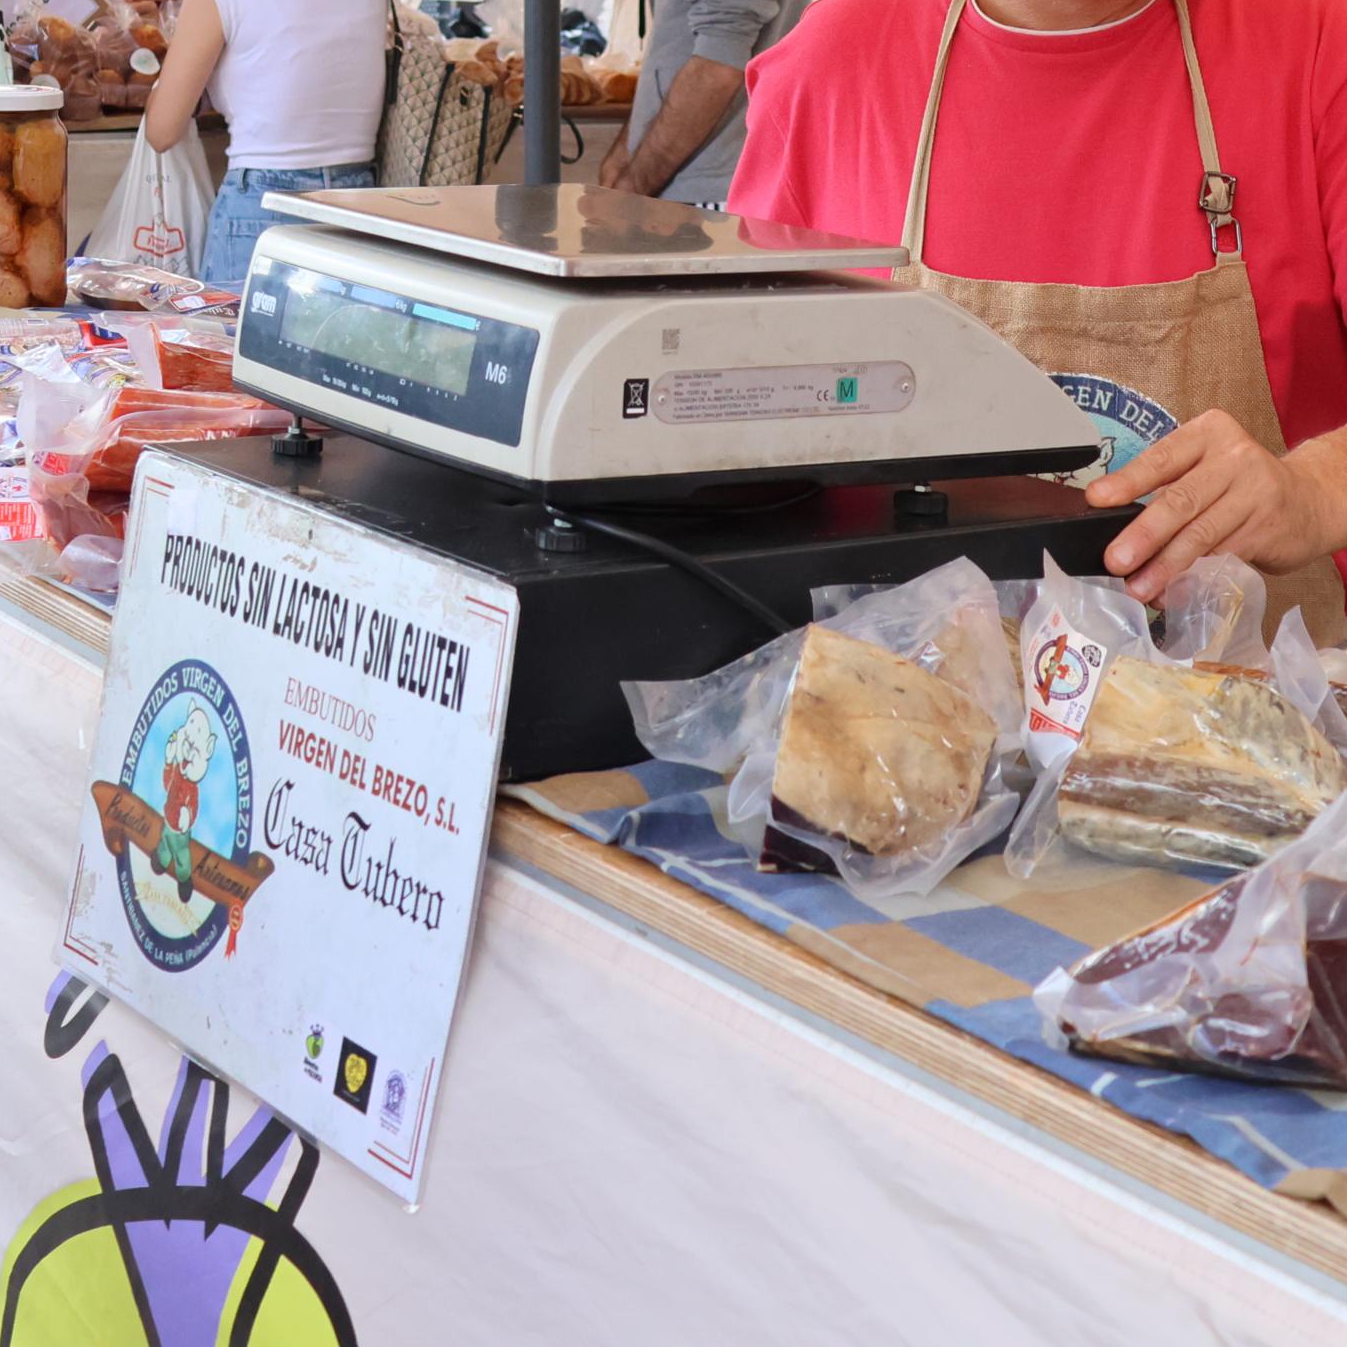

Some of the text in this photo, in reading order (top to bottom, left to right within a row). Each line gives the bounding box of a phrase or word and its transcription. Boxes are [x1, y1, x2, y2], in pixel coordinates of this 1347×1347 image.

[251, 290, 278, 313] gram
[485, 361, 508, 384] M6
[840, 381, 854, 398] M
[1120, 400, 1165, 444] DEL
[161, 534, 471, 713] PRODUCTOS SIN LACTOSA Y SIN GLUTEN
[284, 677, 377, 742] EMBUTIDOS
[122, 667, 251, 850] EMBUTIDOS VIRGEN DEL BREZO
[279, 719, 460, 835] VIRGEN DEL BREZO, S.L.
[264, 777, 446, 930] Casa Tubero
